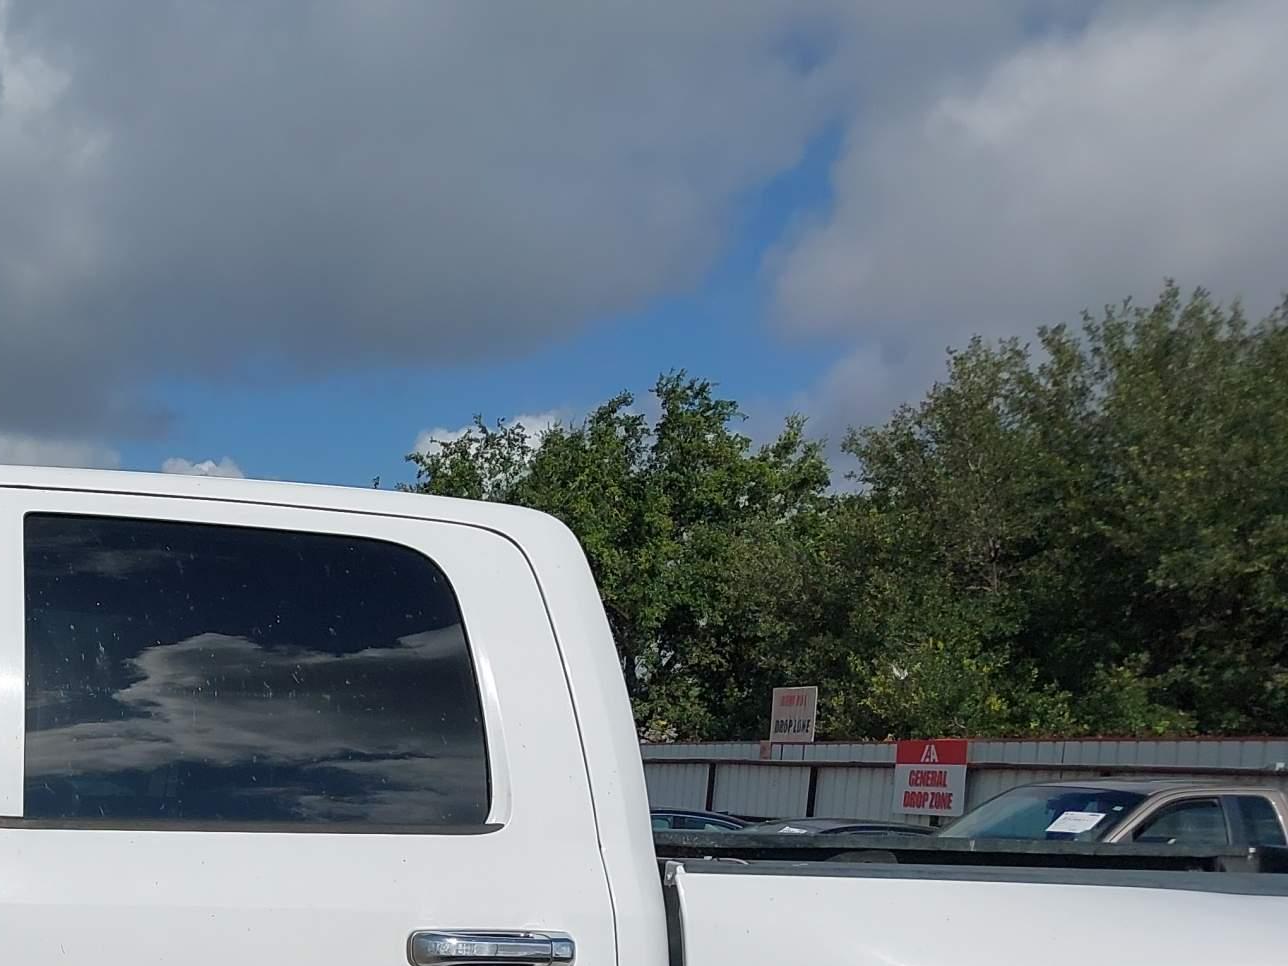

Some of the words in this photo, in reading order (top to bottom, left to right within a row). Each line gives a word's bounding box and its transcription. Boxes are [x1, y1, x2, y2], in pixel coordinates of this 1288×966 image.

[908, 769, 948, 788] GENERAL
[902, 791, 929, 809] DROP
[929, 792, 954, 810] ZONE
